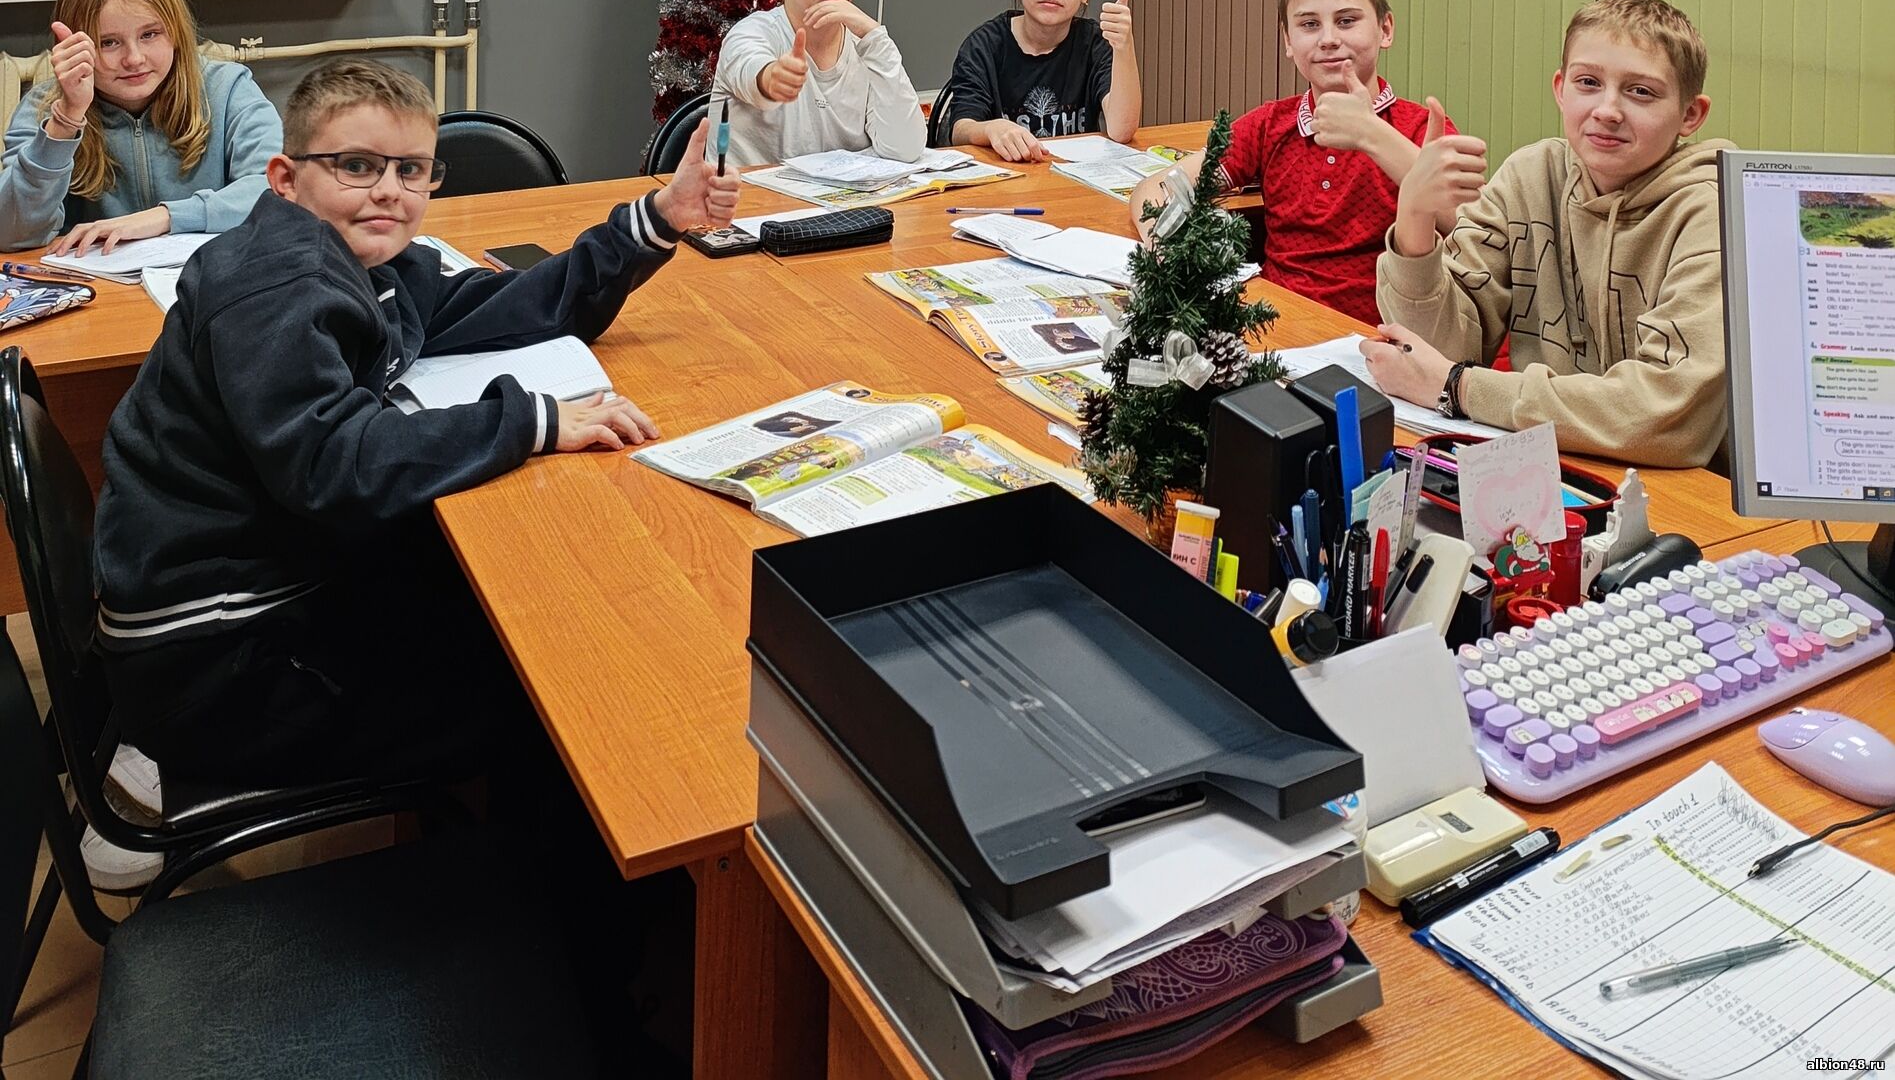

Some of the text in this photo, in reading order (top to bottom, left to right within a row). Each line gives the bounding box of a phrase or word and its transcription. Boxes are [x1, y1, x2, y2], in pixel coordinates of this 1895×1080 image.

[1347, 550, 1356, 596] MARKER
[1645, 792, 1699, 830] In touch 1
